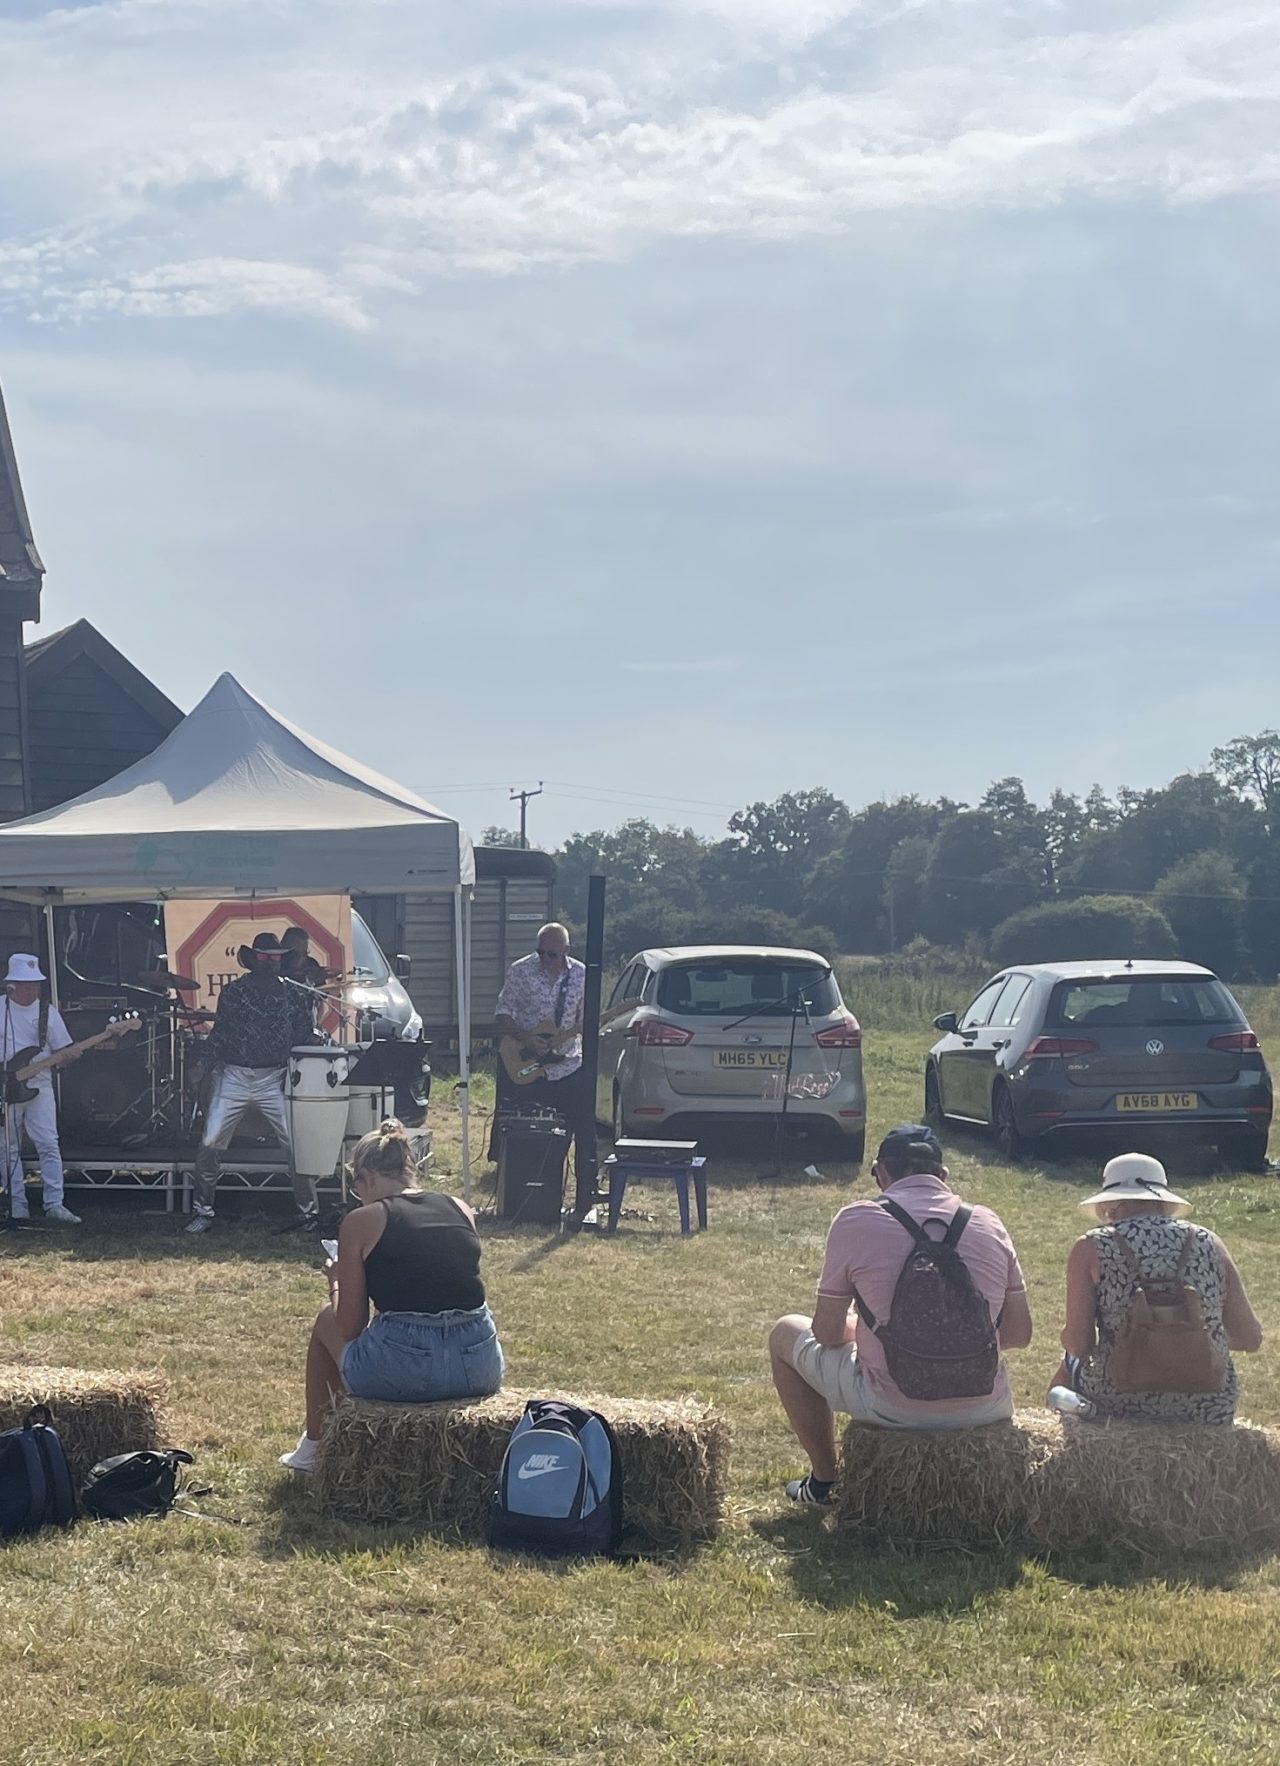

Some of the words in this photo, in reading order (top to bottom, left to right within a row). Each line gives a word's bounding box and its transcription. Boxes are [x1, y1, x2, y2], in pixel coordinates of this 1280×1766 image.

[718, 1052, 756, 1065] MH65
[760, 1052, 786, 1066] YLC
[1123, 1094, 1159, 1108] AV68
[1163, 1094, 1190, 1107] AYG
[526, 1454, 560, 1469] NIKE
